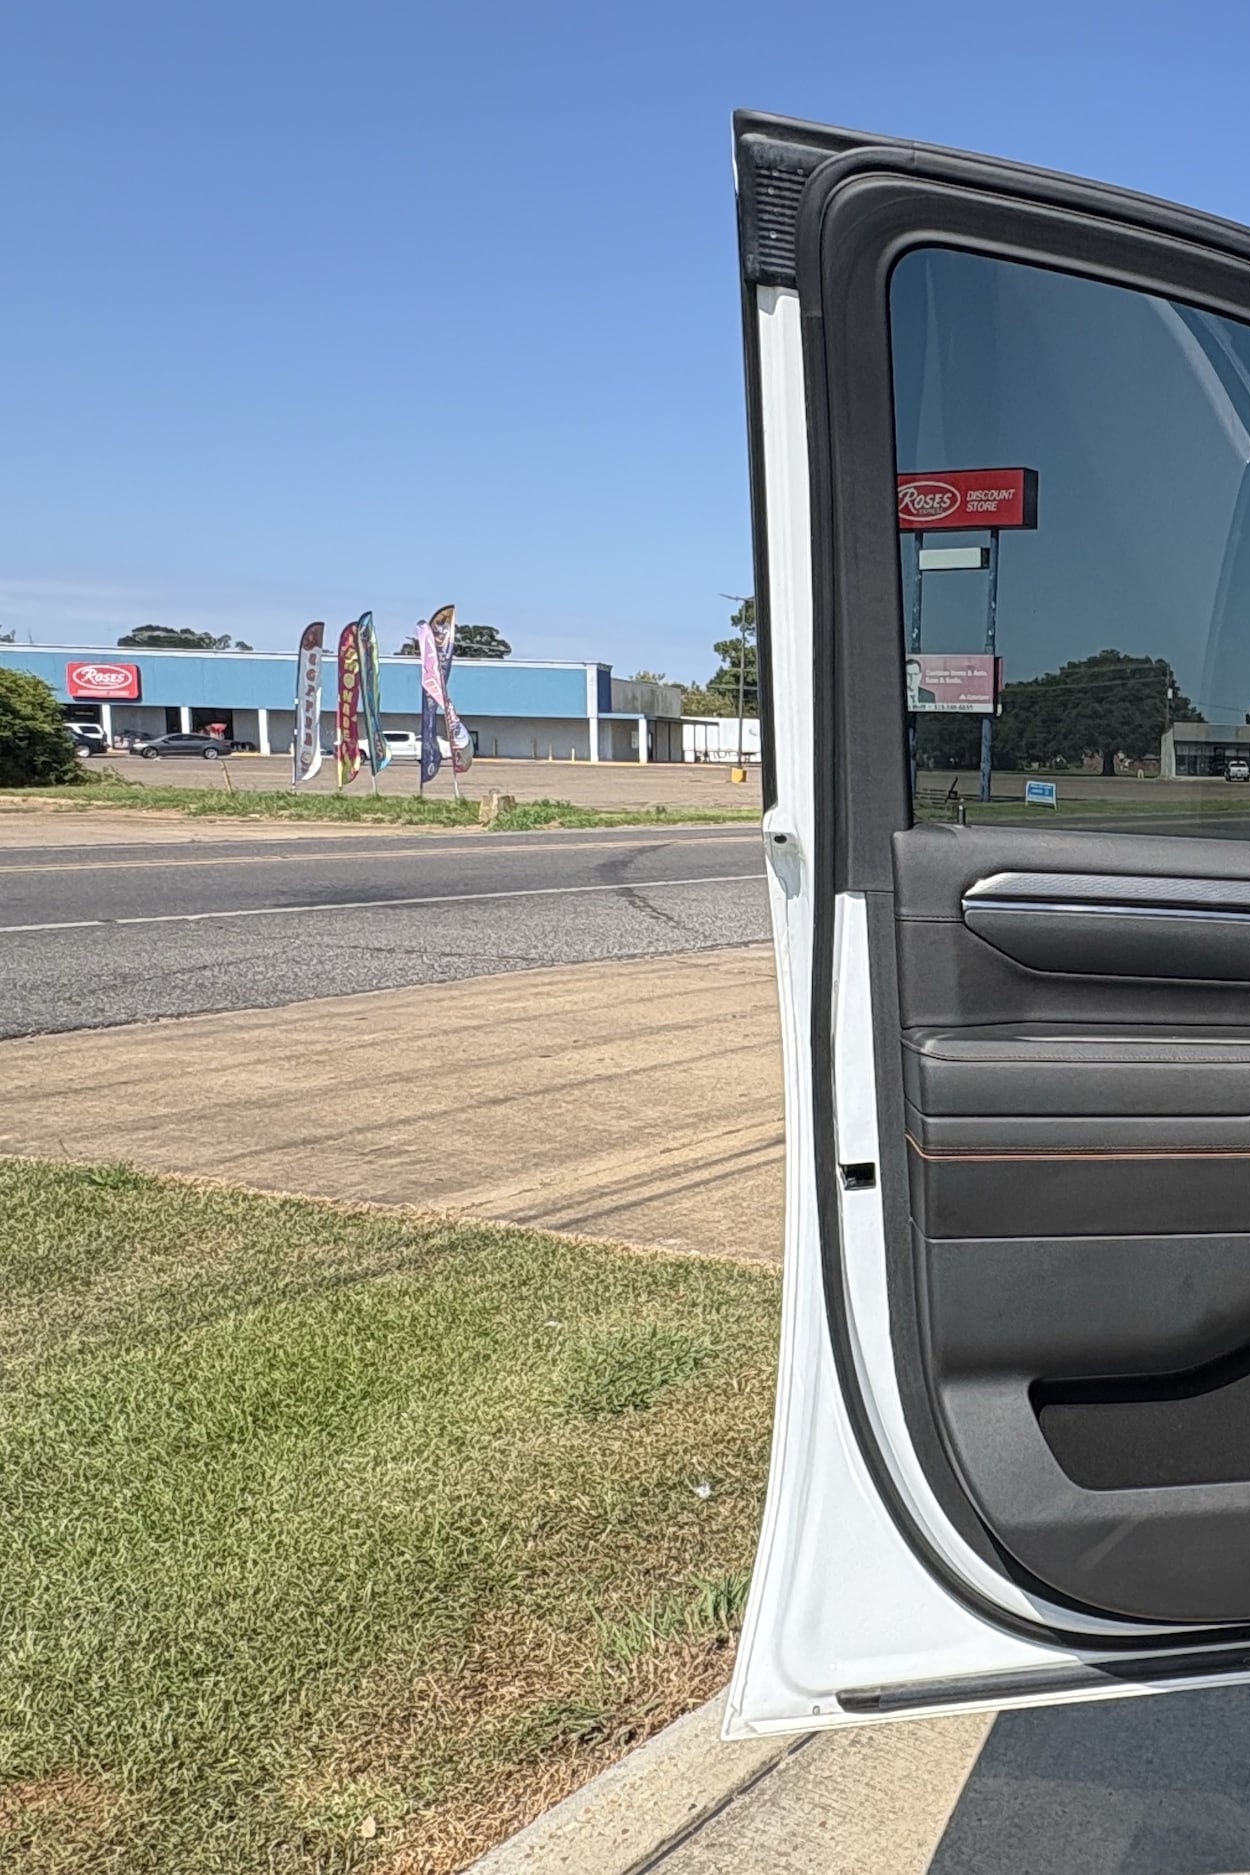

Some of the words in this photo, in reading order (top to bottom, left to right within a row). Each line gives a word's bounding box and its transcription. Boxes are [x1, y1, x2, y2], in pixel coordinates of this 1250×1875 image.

[898, 488, 952, 513] ROSES
[966, 489, 1015, 501] DISCOUNT
[966, 501, 998, 512] STORE
[81, 668, 125, 685] ROSES
